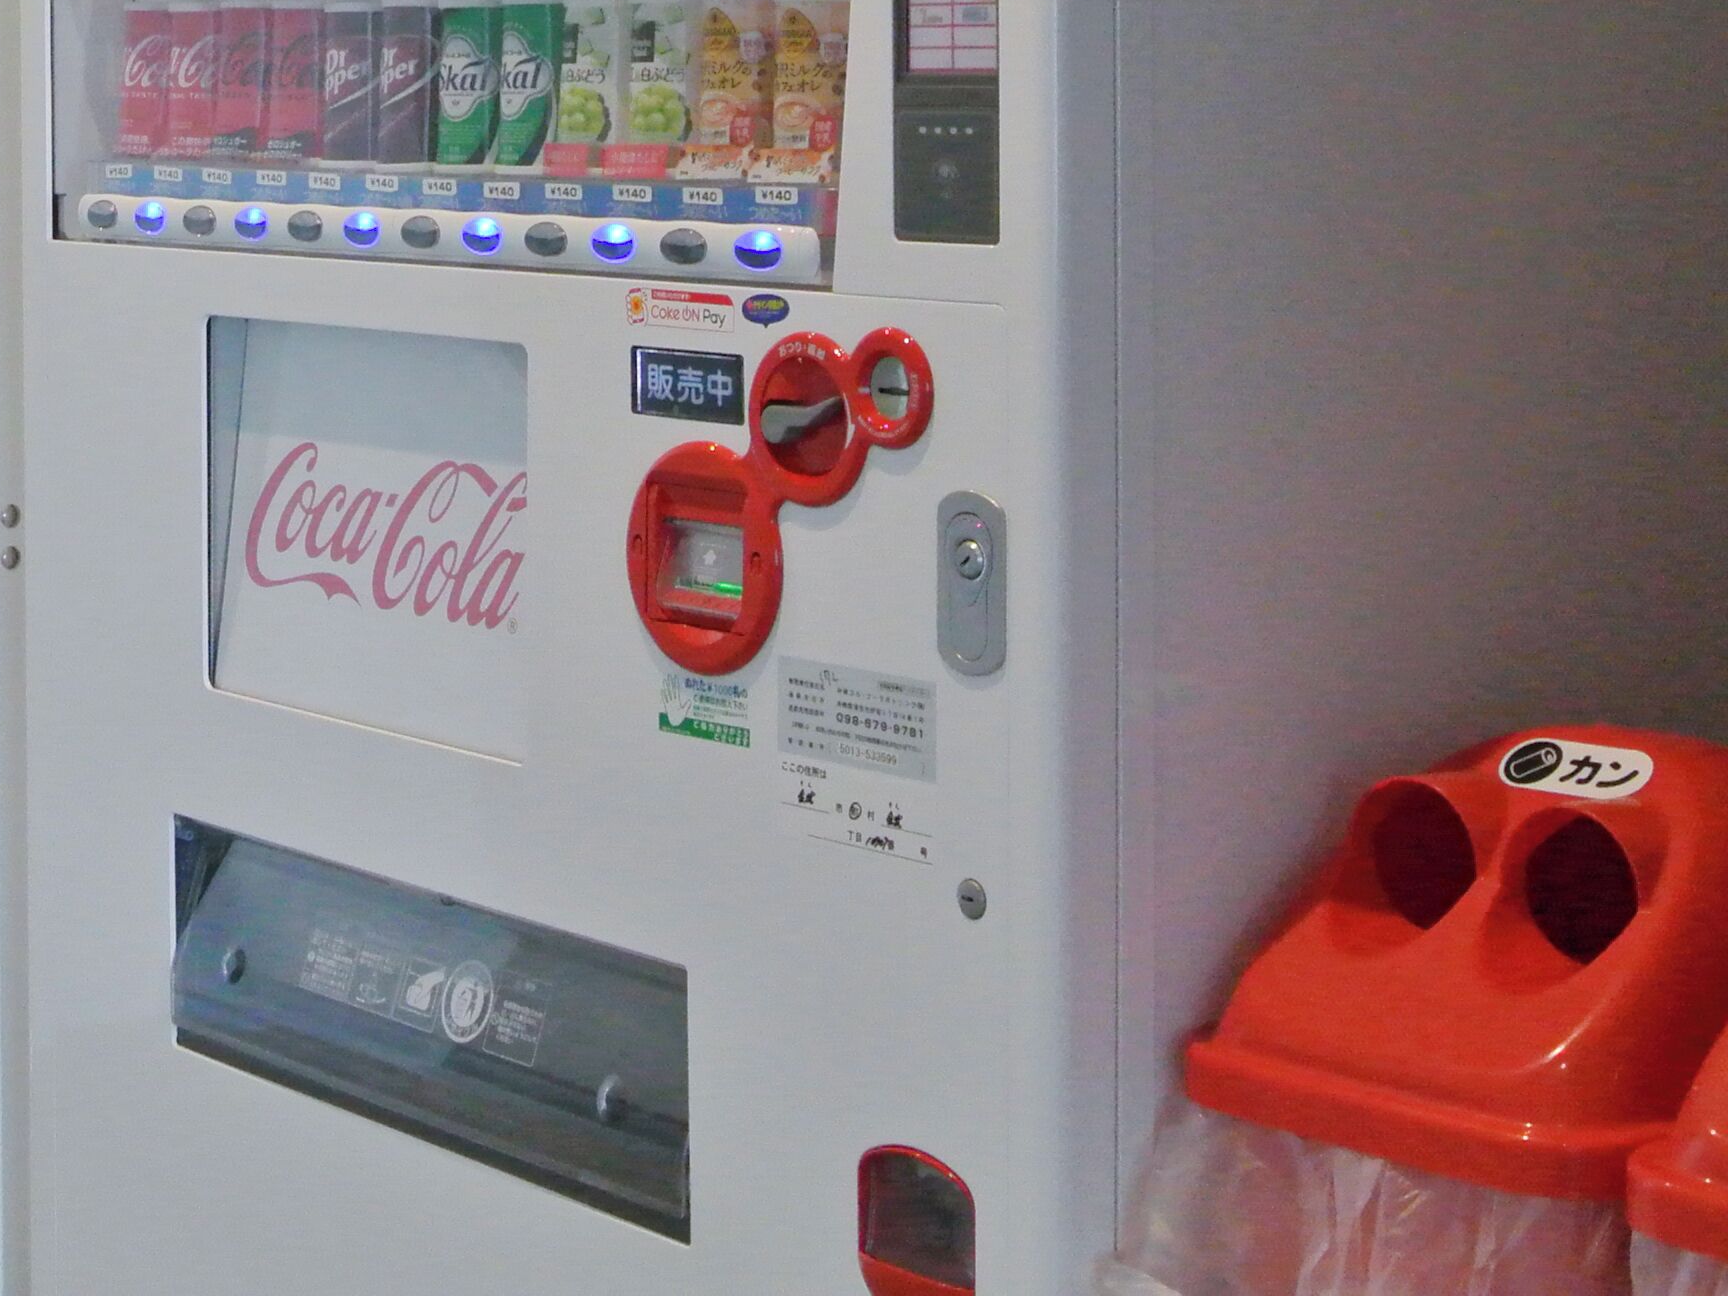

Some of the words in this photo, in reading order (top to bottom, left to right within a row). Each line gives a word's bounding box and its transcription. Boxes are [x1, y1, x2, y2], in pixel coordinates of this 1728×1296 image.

[502, 55, 542, 90] kal
[640, 66, 685, 83] 白ぶどう
[107, 167, 129, 177] ¥140
[158, 169, 180, 179] ¥140
[206, 171, 228, 182] ¥140
[260, 173, 283, 184] ¥140
[313, 176, 336, 187] ¥140
[370, 178, 394, 189] ¥140
[427, 181, 453, 192] ¥140
[488, 186, 515, 198] ¥140
[549, 185, 578, 198] ¥140
[617, 187, 647, 200] ¥140
[688, 190, 718, 203] ¥140
[760, 188, 793, 202] ¥140
[650, 304, 680, 321] Coke
[681, 305, 700, 322] ON
[702, 308, 726, 329] Pay
[647, 362, 733, 408] 販売中
[245, 441, 528, 630] Coca-Cola
[781, 761, 827, 779] ここの住所は
[1560, 754, 1640, 789] カン
